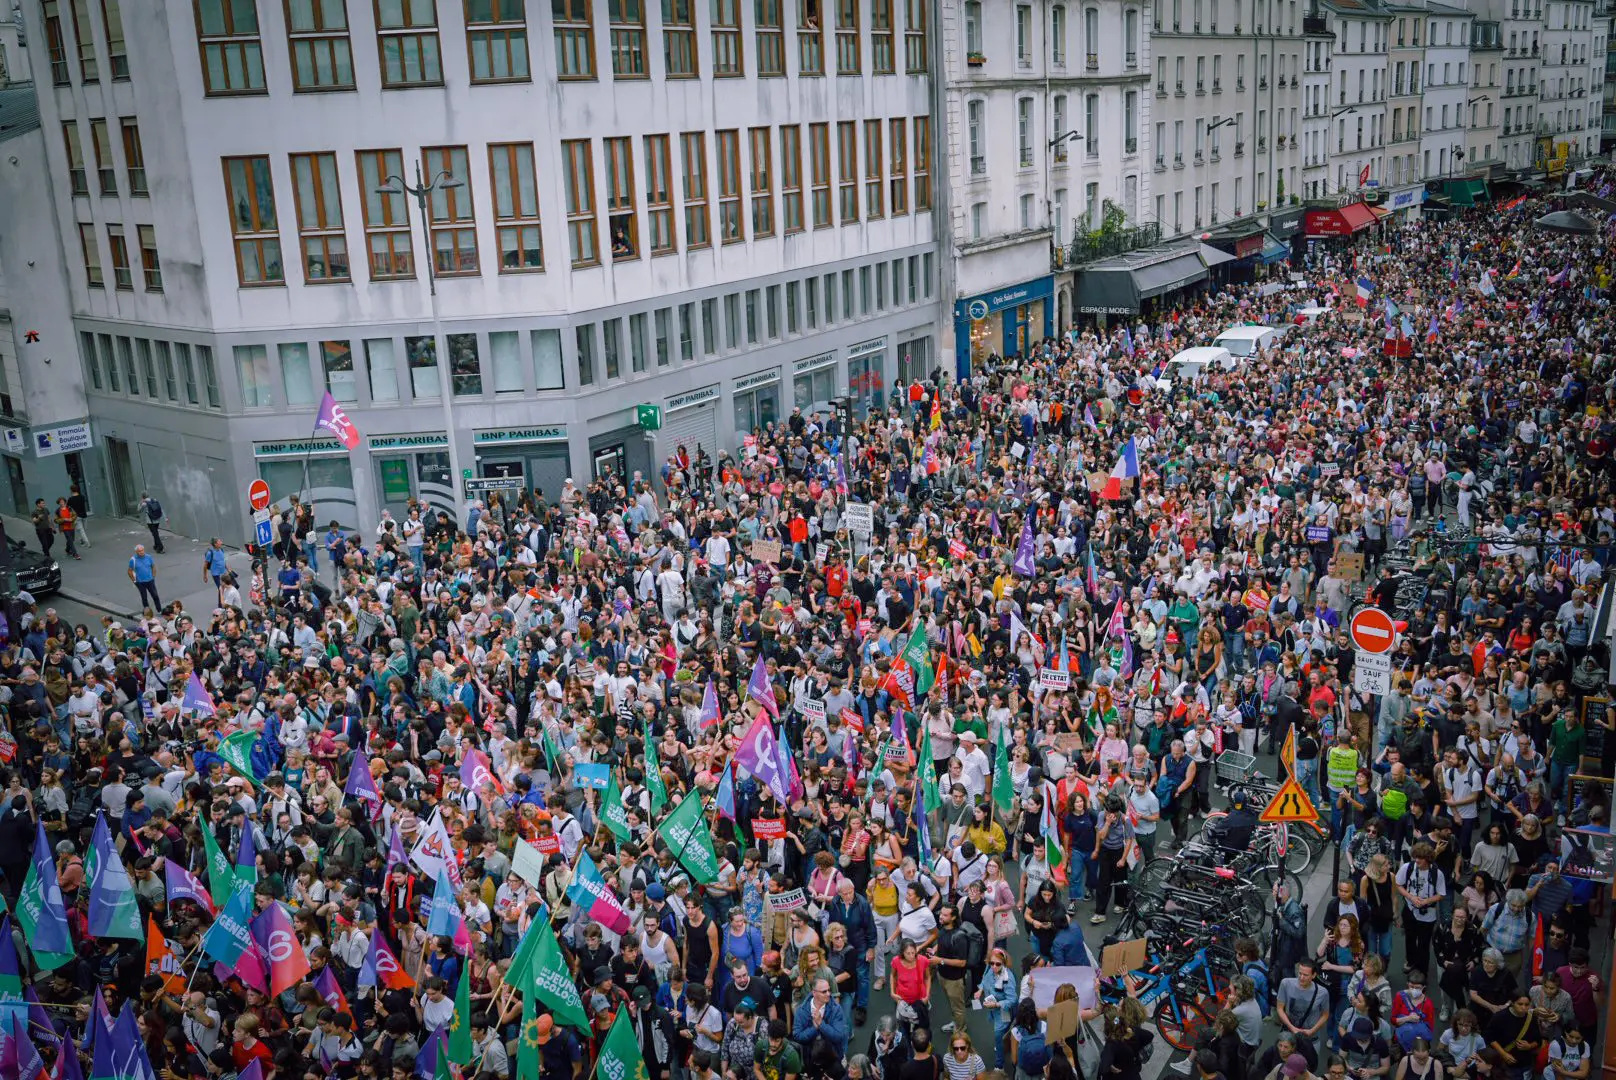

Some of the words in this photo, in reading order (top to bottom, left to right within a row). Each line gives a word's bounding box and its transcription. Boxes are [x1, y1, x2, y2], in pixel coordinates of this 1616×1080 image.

[1080, 306, 1108, 314] ESPACE
[1108, 307, 1130, 315] MODE
[796, 361, 809, 370] BNP
[809, 354, 833, 367] PARIBAS
[736, 379, 750, 389] BNP
[750, 371, 776, 385] PARIBAS
[669, 397, 684, 408] BNP
[685, 389, 714, 404] PARIBAS
[59, 434, 87, 444] Boutique
[481, 432, 506, 440] BNP
[509, 428, 560, 439] PARIBAS
[60, 441, 88, 451] Solidaire
[371, 437, 396, 447] BNP
[399, 434, 449, 445] PARIBAS
[261, 444, 286, 453] BNP
[289, 441, 341, 451] PARIBAS
[1376, 659, 1388, 667] BUS
[1363, 669, 1382, 678] SAUF
